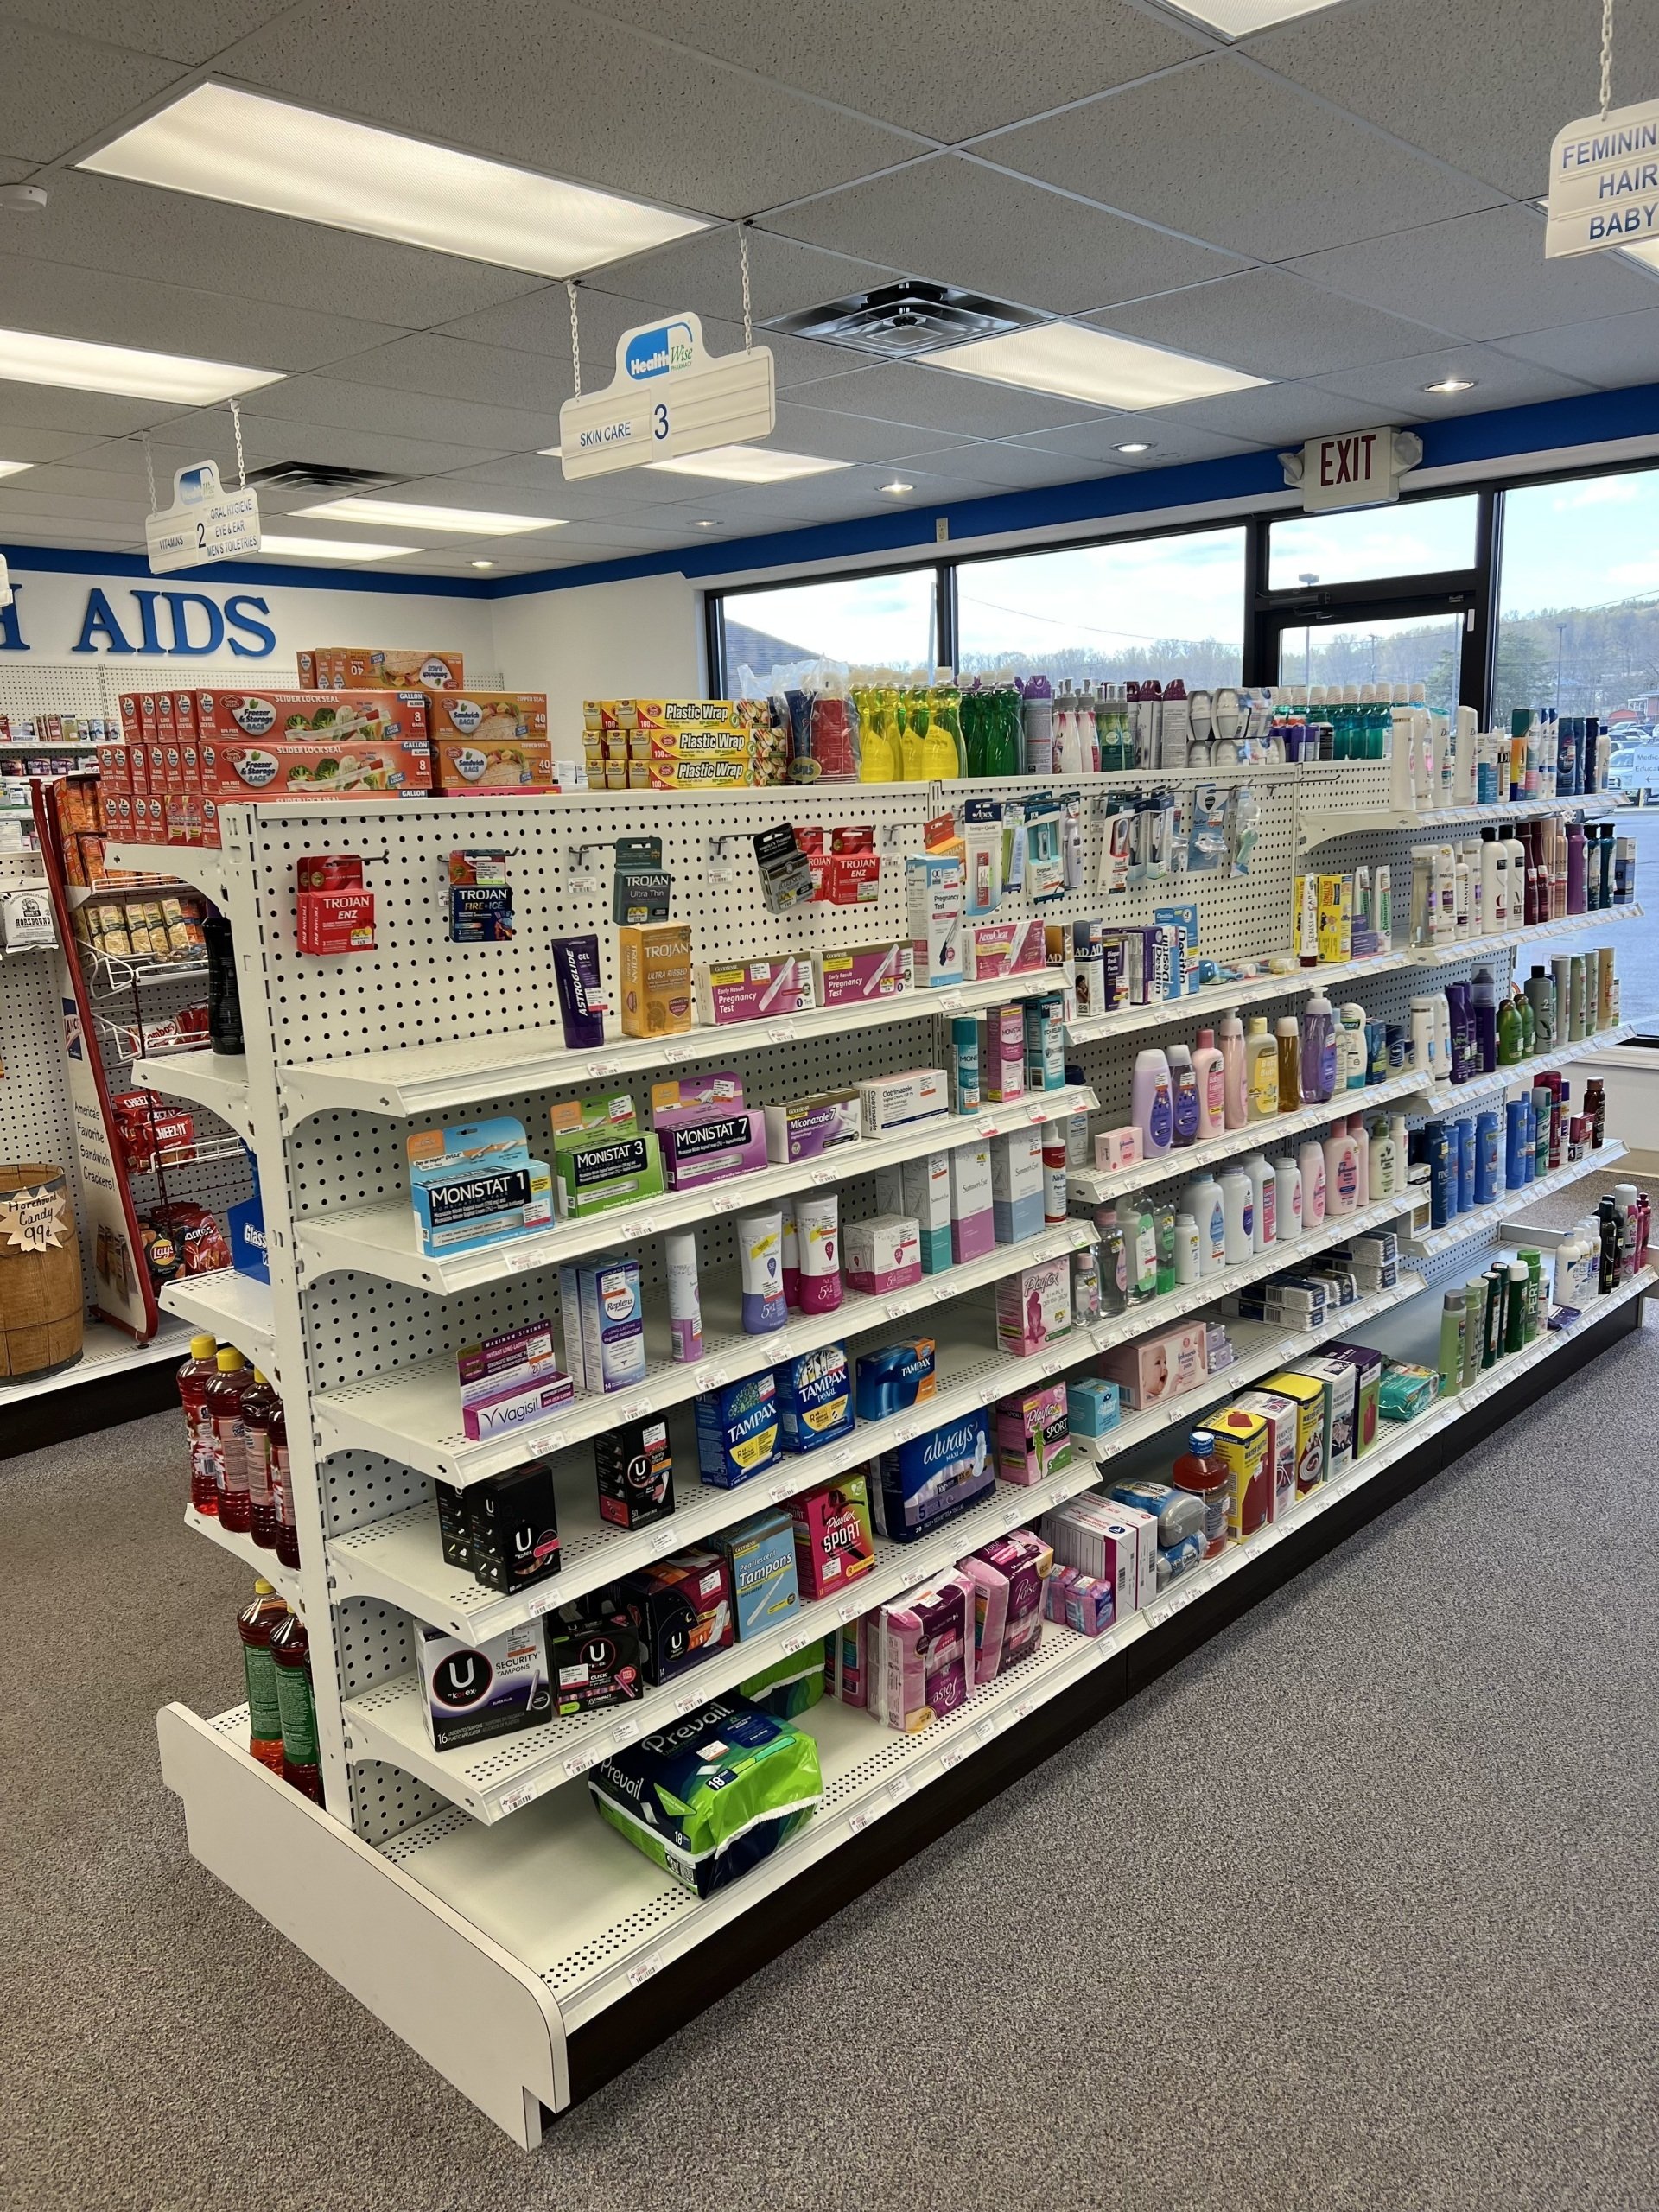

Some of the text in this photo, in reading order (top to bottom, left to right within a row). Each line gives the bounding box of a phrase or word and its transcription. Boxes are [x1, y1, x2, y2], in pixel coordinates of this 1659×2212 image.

[1563, 124, 1659, 168] FEMININ
[1599, 163, 1658, 198] HAIR
[1590, 202, 1659, 239] BABY
[630, 344, 693, 376] Health Wise
[671, 360, 692, 371] PHARMACY
[654, 404, 669, 439] 3
[580, 422, 631, 447] SKIN CARE
[1321, 435, 1376, 486] EXIT
[211, 499, 252, 519] ORAL HYGIENE
[197, 523, 206, 548] 2
[216, 521, 245, 537] EYE & EAR
[160, 536, 183, 550] VITAMINS
[207, 536, 257, 557] MEN'S TOILETRIES
[72, 588, 276, 658] AIDS
[275, 695, 301, 703] SLIDER
[321, 695, 340, 703] SEAL
[246, 715, 274, 724] Storage
[415, 712, 421, 722] 8
[534, 714, 545, 723] 40
[665, 703, 728, 721] Plastic Wrap
[680, 734, 744, 751] Plastic Wrap
[248, 767, 276, 776] Storage
[419, 760, 425, 770] 8
[539, 760, 550, 770] 40
[678, 763, 743, 779] Plastic Wrap
[976, 810, 993, 819] Apex
[841, 859, 876, 868] TROJAN
[626, 876, 669, 887] TROJAN
[323, 896, 370, 909] TROJAN
[460, 889, 508, 899] TROJAN
[934, 894, 958, 903] Pregnancy
[338, 909, 358, 919] ENZ
[465, 900, 503, 911] FIRE ICE
[978, 931, 1009, 942] AccuClear
[644, 944, 690, 958] TROJAN
[569, 949, 589, 1017] ASTROGLIDE
[648, 969, 687, 980] ULTRA RIBBED
[829, 977, 862, 990] Pregnancy
[718, 992, 756, 1007] Pregnancy
[829, 989, 842, 998] Test
[720, 1004, 734, 1014] Test
[882, 1086, 912, 1097] Clotrimazole
[74, 1102, 99, 1120] America's
[790, 1108, 836, 1130] Miconazole 7
[77, 1122, 105, 1143] Favorite
[677, 1118, 747, 1147] MONISTAT 7
[80, 1145, 110, 1167] Sandwich
[577, 1141, 644, 1168] MONISTAT 3
[84, 1167, 115, 1191] Crackers!
[432, 1176, 511, 1207] MONISTAT
[517, 1172, 525, 1190] 1
[19, 1208, 54, 1227] Candy
[1024, 1272, 1058, 1297] Playtex
[607, 1298, 632, 1311] Replens
[1529, 1281, 1538, 1315] PERT
[901, 1357, 931, 1378] TAMPAX
[799, 1369, 847, 1403] TAMPAX
[499, 1397, 538, 1423] Vagisil
[1027, 1402, 1057, 1429] Playtex
[727, 1399, 777, 1444] TAMPAX
[1046, 1418, 1068, 1438] SPORT
[924, 1426, 974, 1465] always
[946, 1452, 959, 1462] MAXI
[634, 1460, 645, 1476] U
[486, 1499, 494, 1514] U
[826, 1510, 855, 1534] Playtex
[515, 1528, 531, 1552] U
[823, 1521, 861, 1553] SPORT
[740, 1549, 776, 1572] Pearlescent
[740, 1552, 793, 1588] Tampons
[847, 1567, 853, 1576] R
[1014, 1578, 1038, 1604] Poise
[671, 1632, 682, 1649] U
[496, 1653, 538, 1670] SECURITY
[589, 1643, 605, 1662] U
[448, 1657, 474, 1688] U
[497, 1664, 531, 1677] TAMPONS
[641, 1701, 734, 1754] Prevail
[438, 1732, 448, 1744] 16
[601, 1756, 644, 1801] Prevail
[709, 1777, 725, 1789] 18
[675, 1831, 683, 1845] 18
